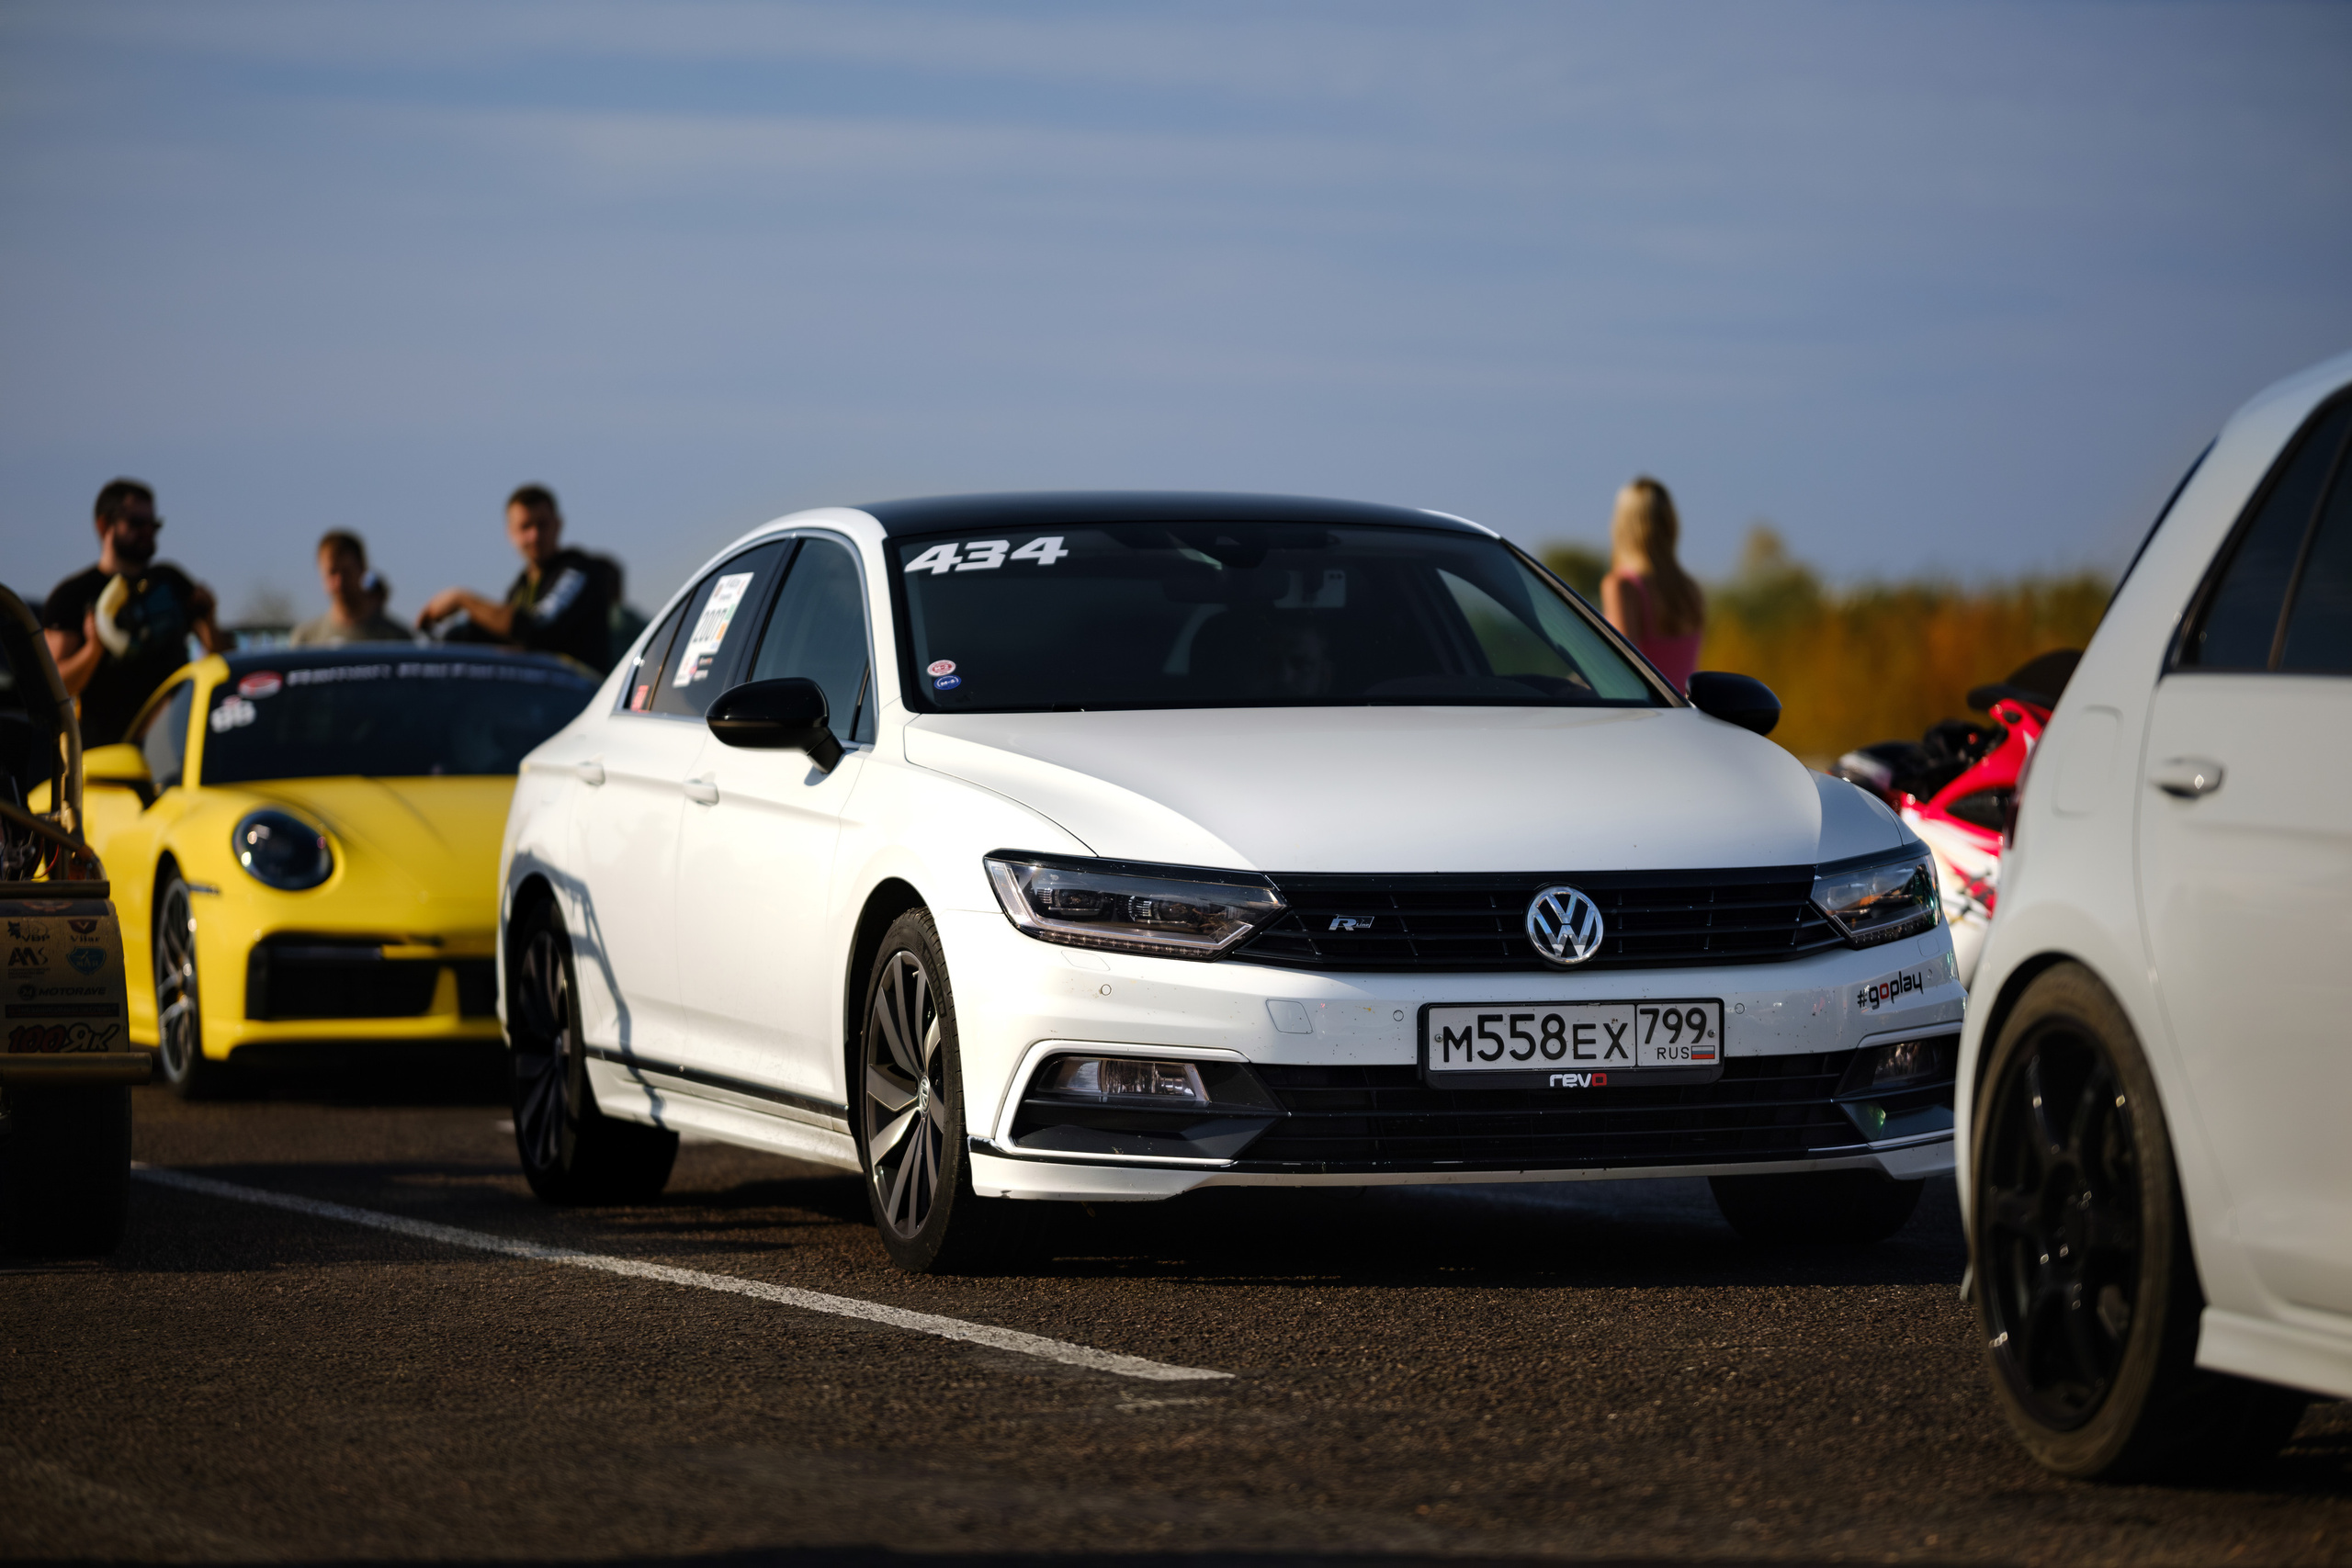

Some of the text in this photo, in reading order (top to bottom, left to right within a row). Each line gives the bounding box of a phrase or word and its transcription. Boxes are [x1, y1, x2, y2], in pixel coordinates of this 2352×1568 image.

[904, 536, 1069, 574] 434
[1857, 970, 1924, 1010] #goplay
[1639, 1008, 1707, 1044] 799
[1657, 1047, 1690, 1060] RUS
[1549, 1073, 1608, 1088] revo
